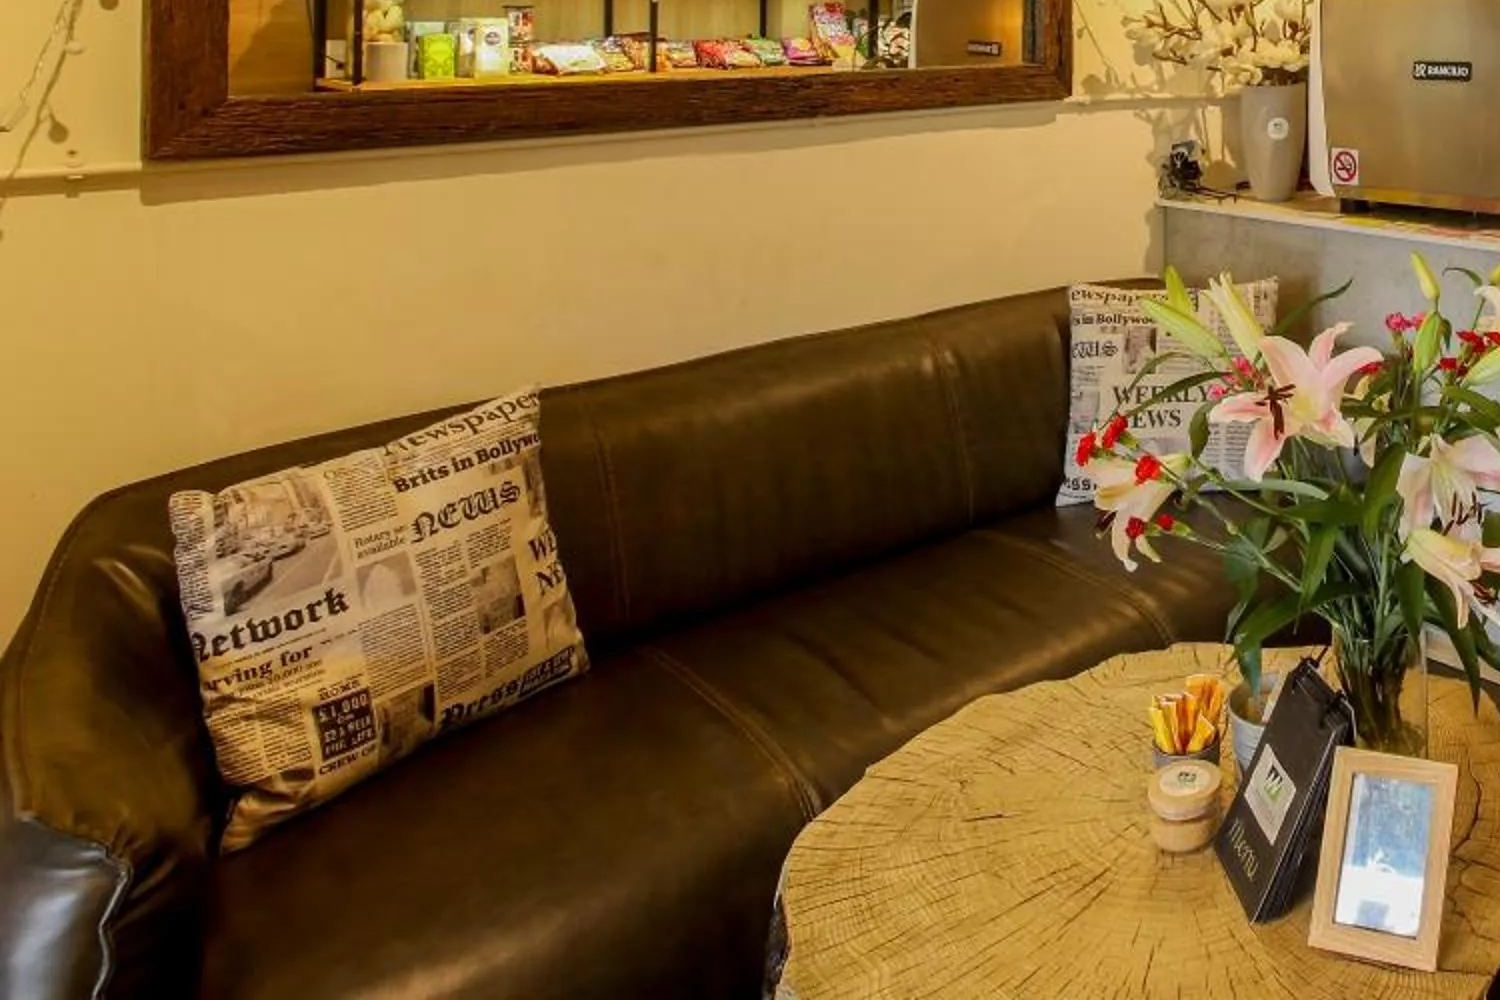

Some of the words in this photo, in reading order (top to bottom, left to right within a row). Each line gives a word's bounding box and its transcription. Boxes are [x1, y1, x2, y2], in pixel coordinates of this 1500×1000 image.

[1130, 408, 1181, 430] EWS
[393, 463, 449, 493] Brits
[451, 455, 475, 474] in
[279, 646, 313, 668] for
